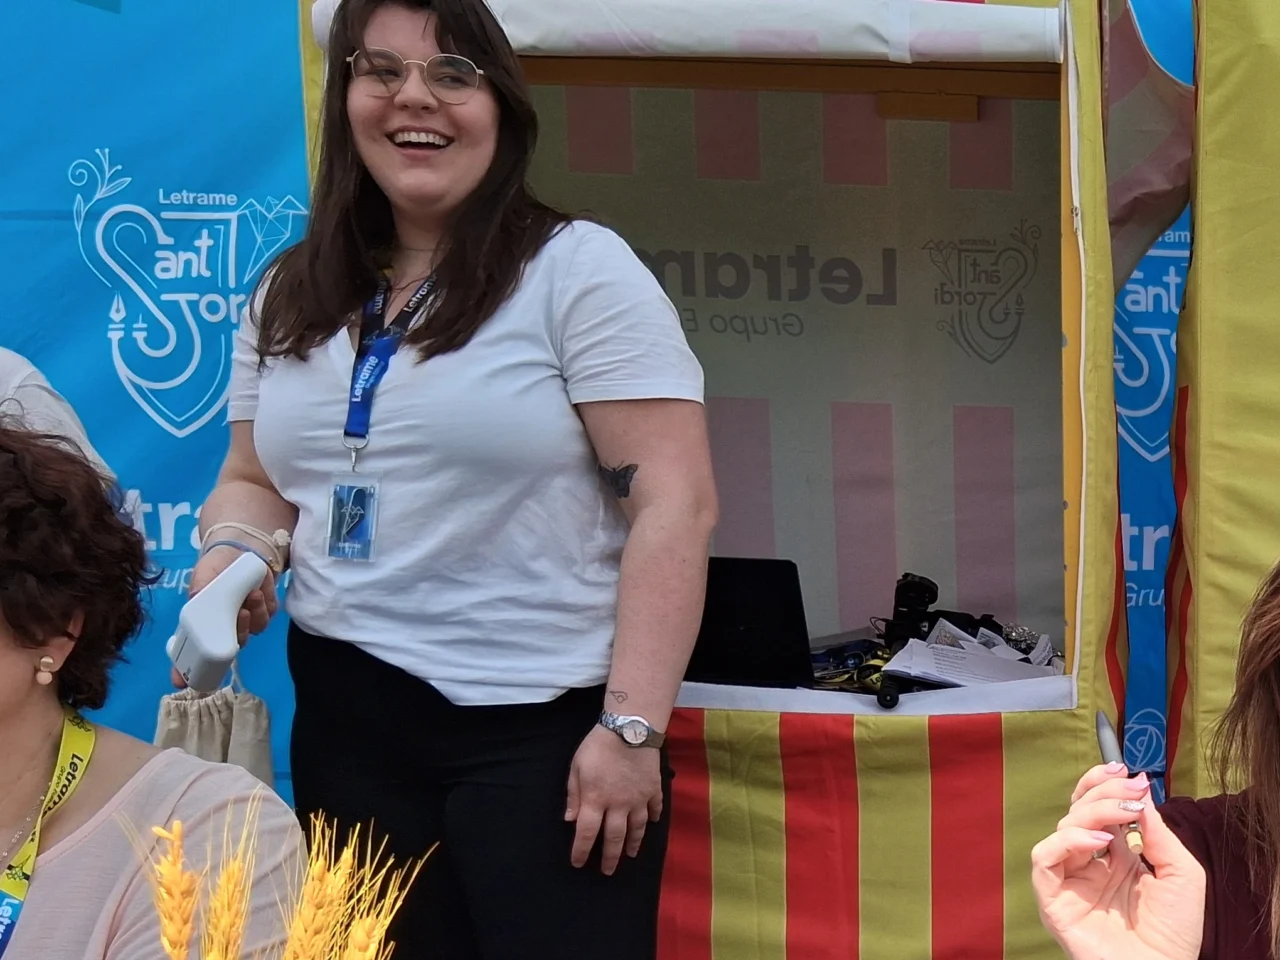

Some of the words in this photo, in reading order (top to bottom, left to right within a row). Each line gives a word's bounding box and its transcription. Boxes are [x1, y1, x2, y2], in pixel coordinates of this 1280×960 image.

[159, 188, 238, 206] Letrame
[352, 355, 379, 402] Letrame
[42, 752, 84, 819] Letram
